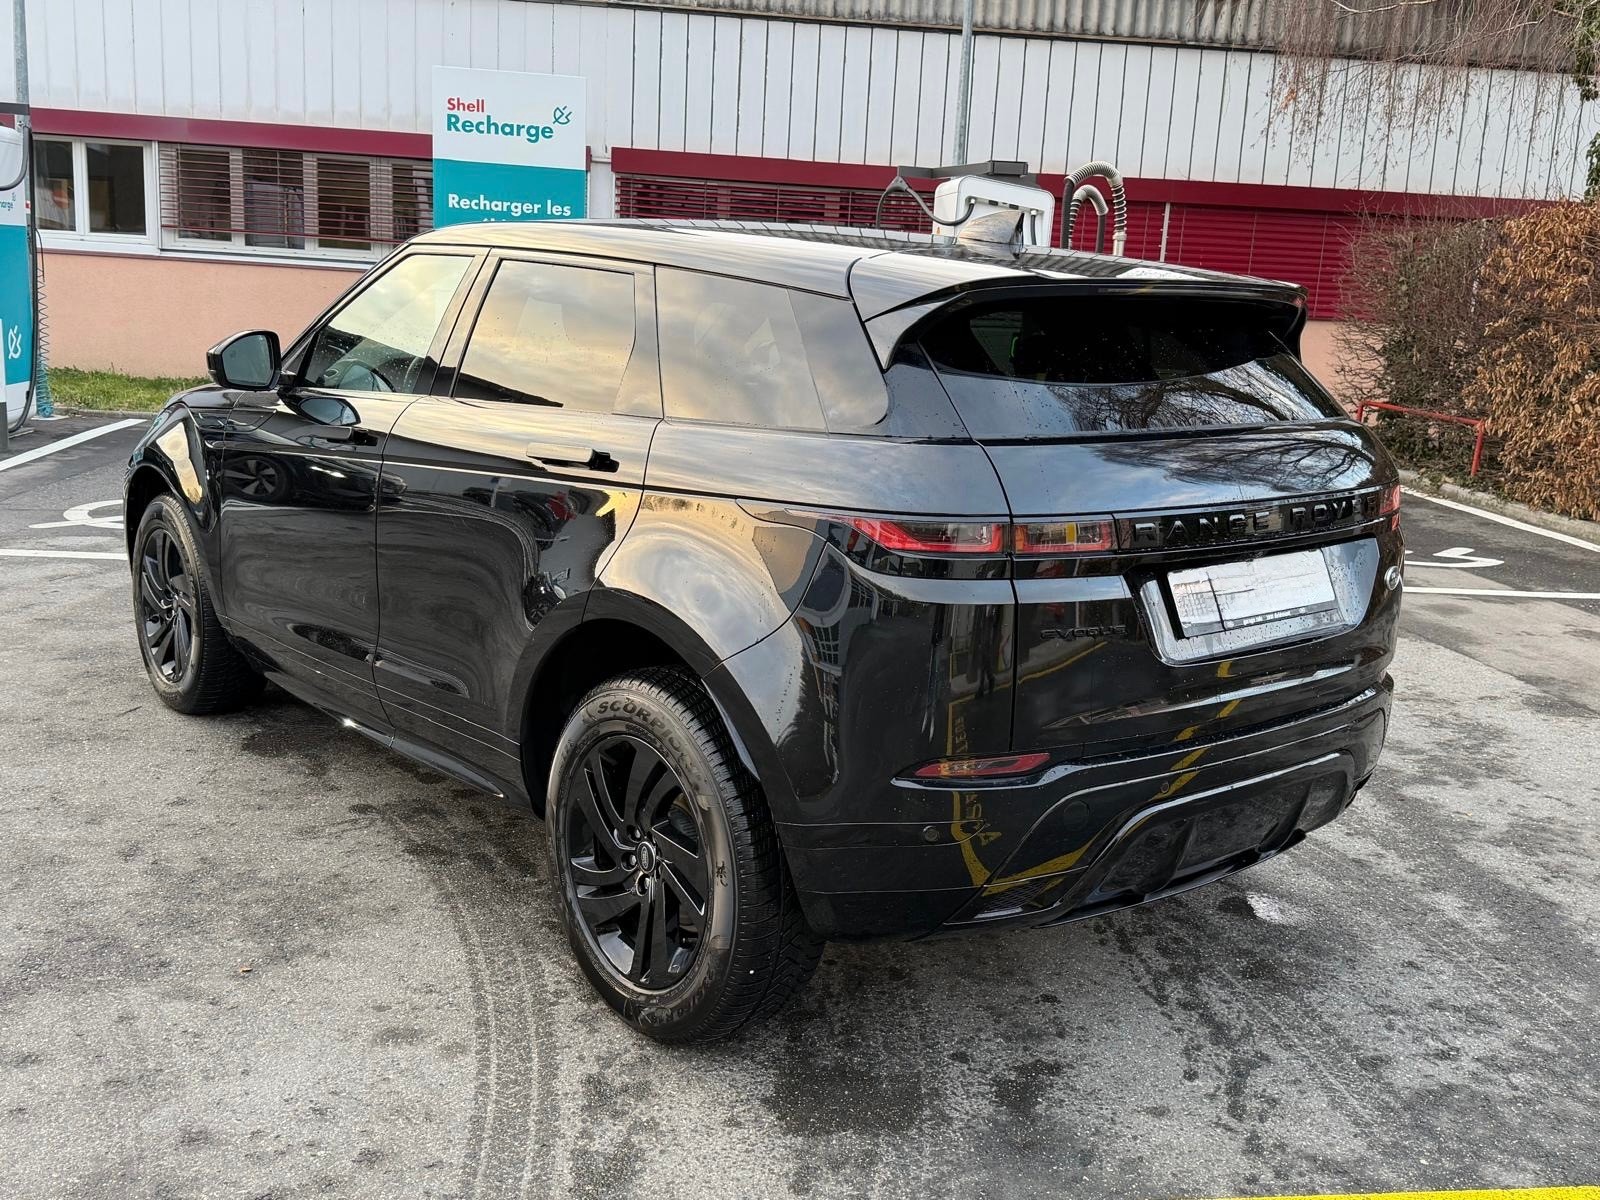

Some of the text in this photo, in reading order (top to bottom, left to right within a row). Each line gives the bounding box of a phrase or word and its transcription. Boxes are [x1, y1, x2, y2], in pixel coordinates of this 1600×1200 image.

[447, 97, 485, 113] Shell
[446, 113, 554, 144] Recharge
[448, 193, 571, 217] Recharger les
[1134, 510, 1271, 545] RANGE
